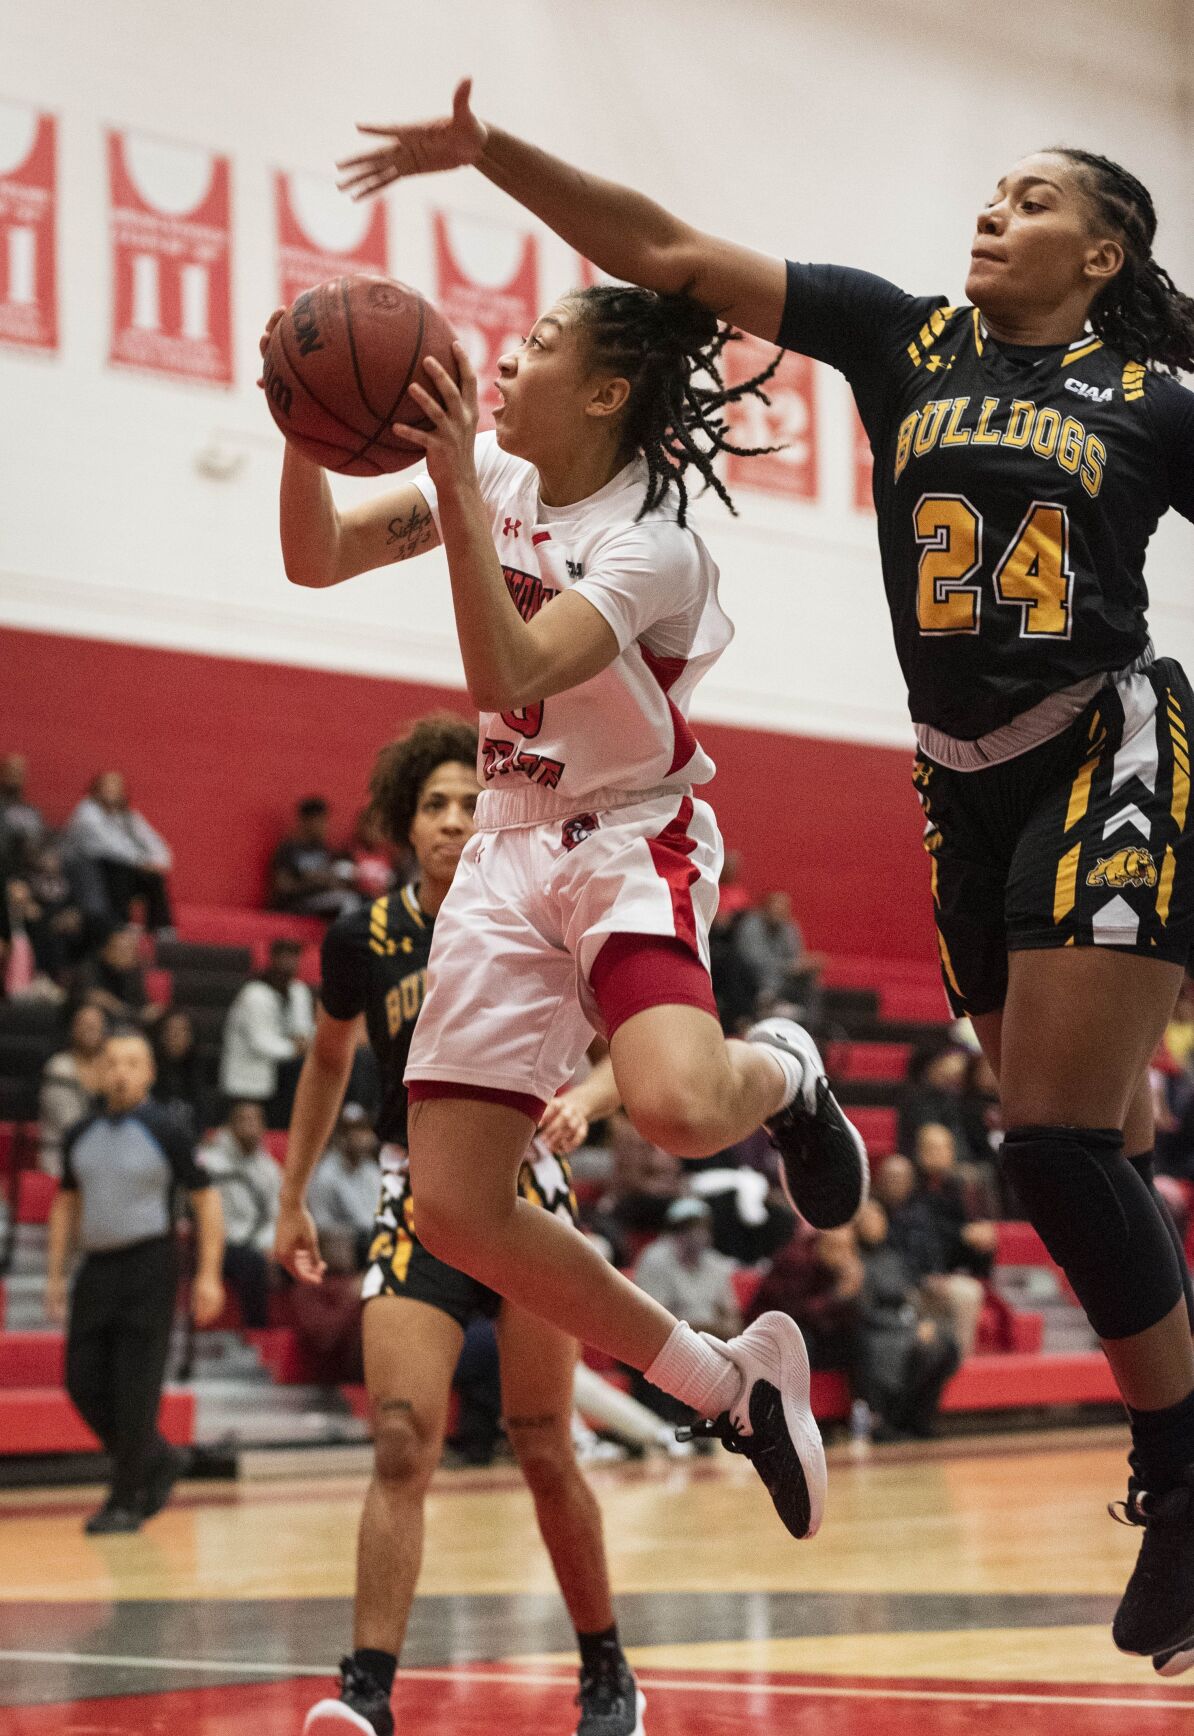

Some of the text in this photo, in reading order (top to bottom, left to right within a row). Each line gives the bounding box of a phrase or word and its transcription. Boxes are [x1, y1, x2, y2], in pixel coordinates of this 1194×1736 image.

[1064, 377, 1114, 402] CIAA
[894, 396, 1107, 498] BULLDOGS
[912, 493, 1075, 640] 24
